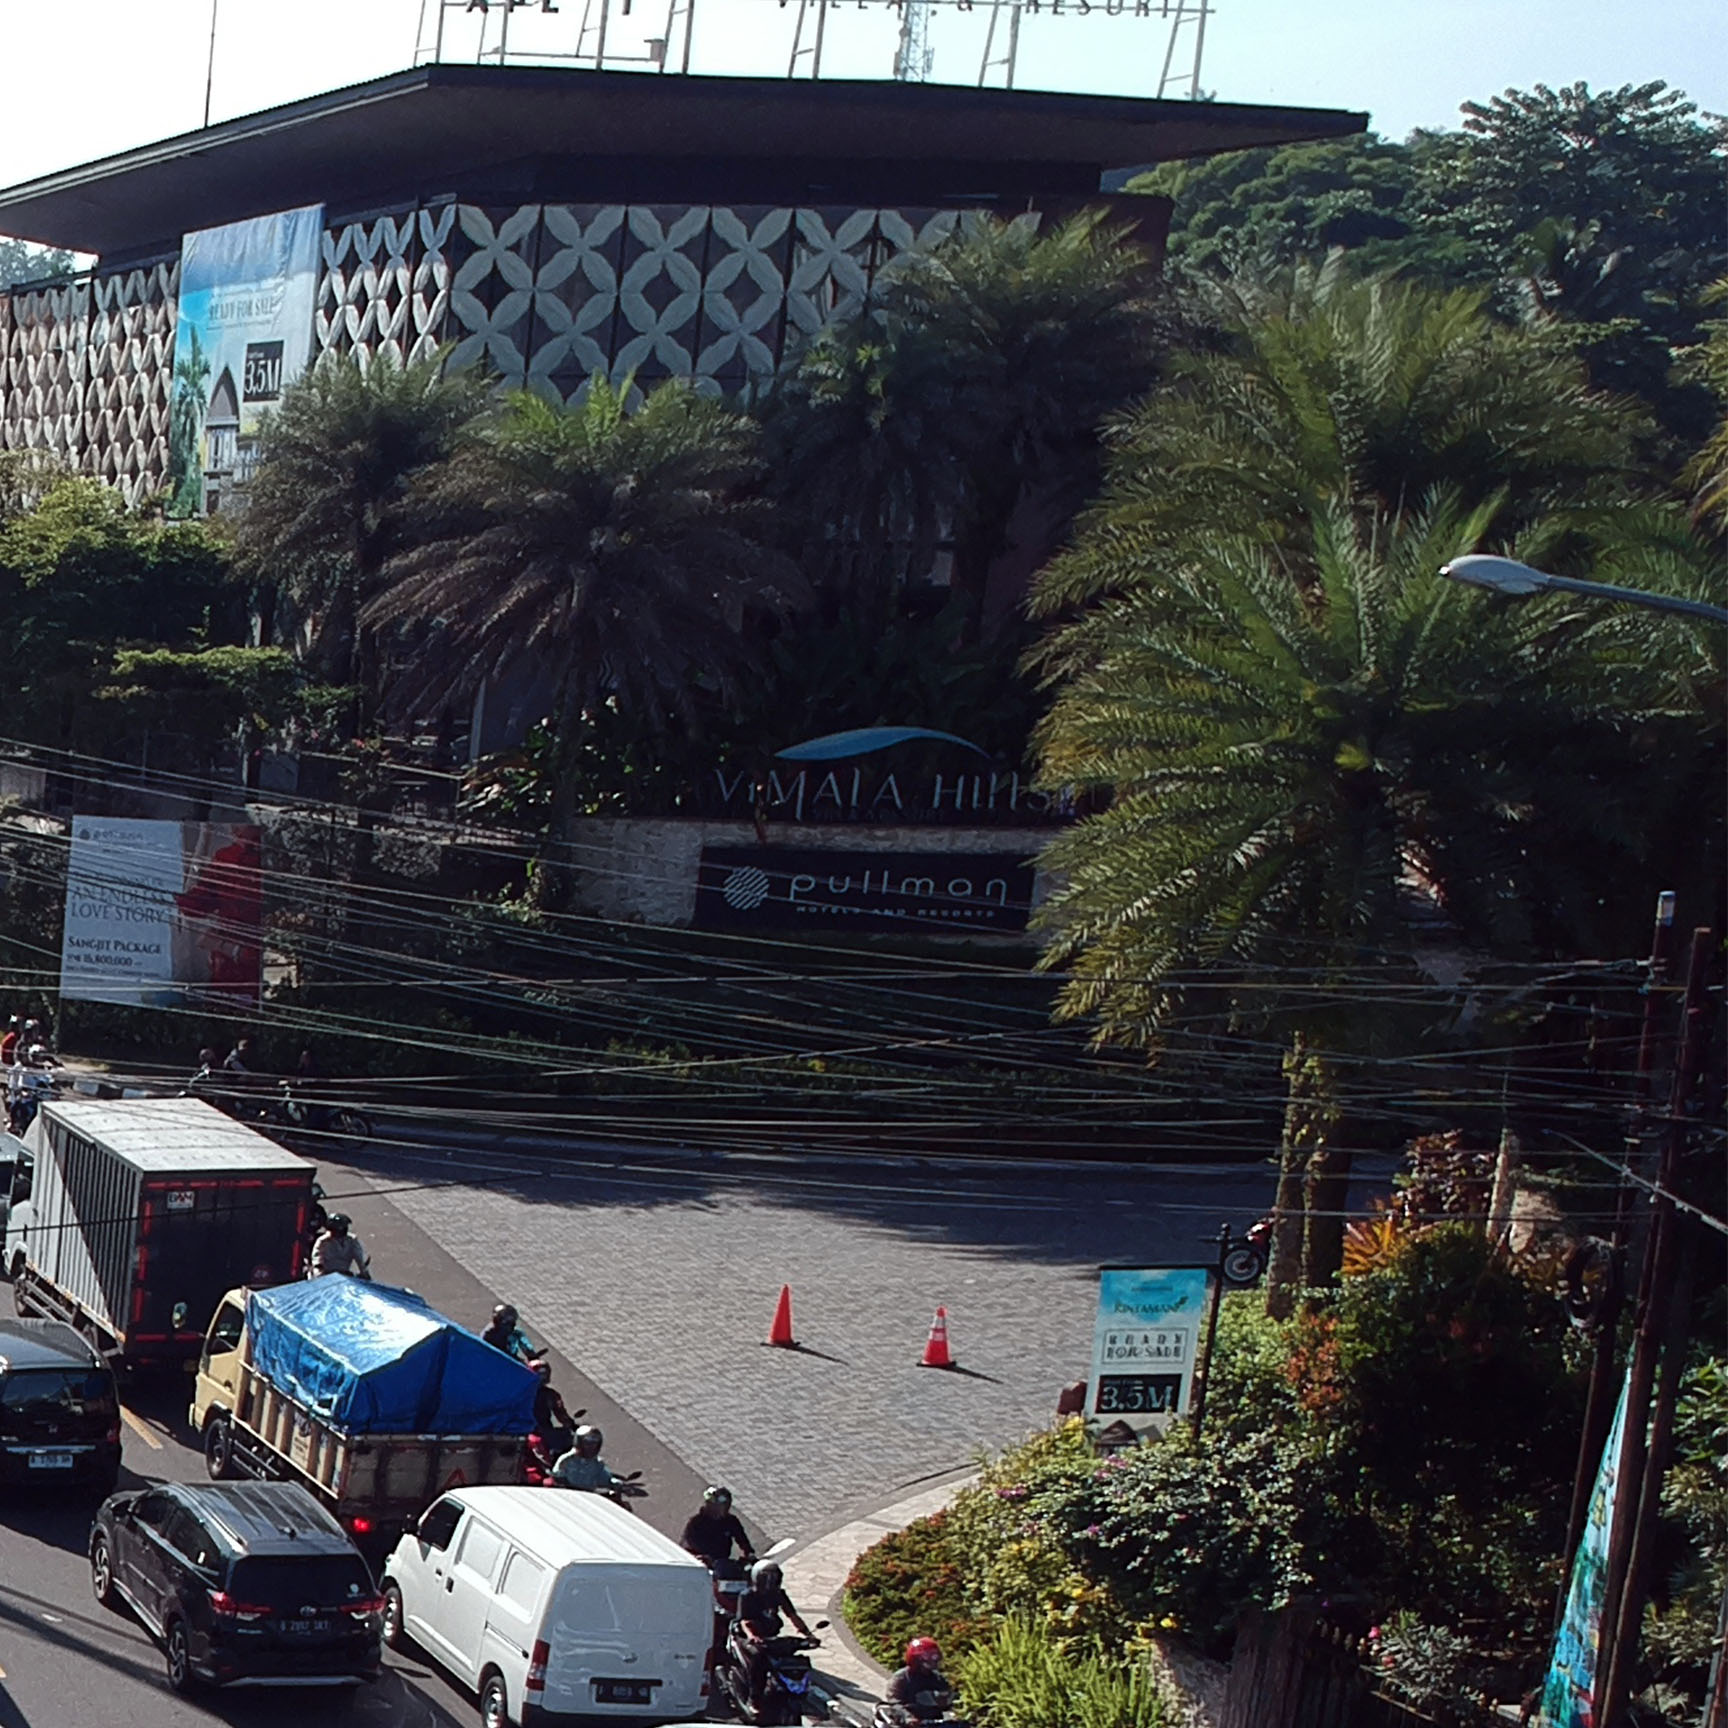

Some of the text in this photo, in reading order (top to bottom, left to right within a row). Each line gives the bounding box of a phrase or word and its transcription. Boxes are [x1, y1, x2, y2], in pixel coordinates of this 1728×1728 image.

[789, 868, 1008, 906] pullman
[71, 902, 166, 923] LOVE STORY
[113, 940, 162, 955] PACKAGE
[1108, 1333, 1184, 1346] READY
